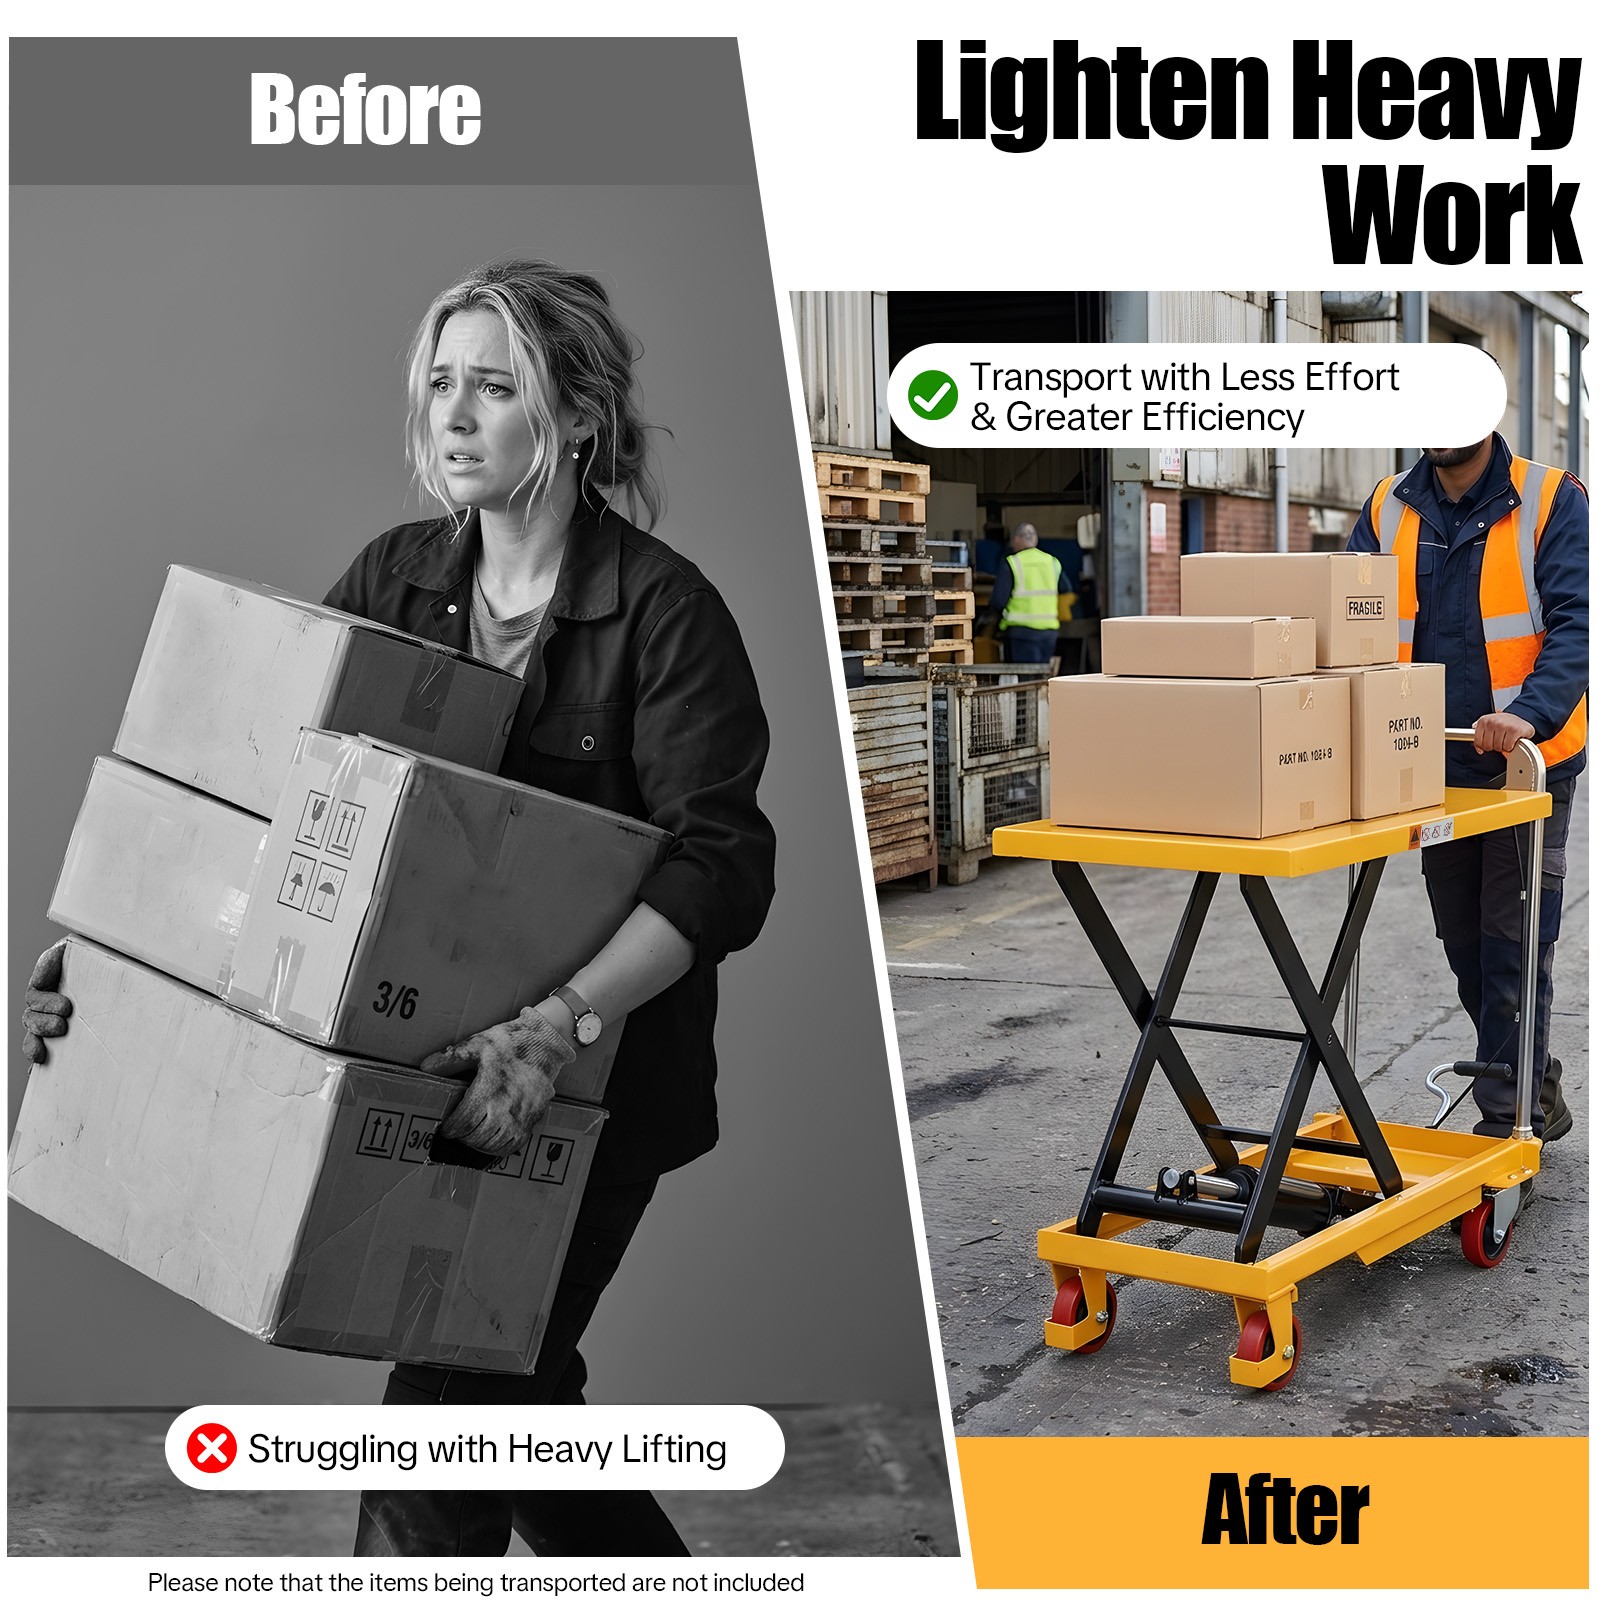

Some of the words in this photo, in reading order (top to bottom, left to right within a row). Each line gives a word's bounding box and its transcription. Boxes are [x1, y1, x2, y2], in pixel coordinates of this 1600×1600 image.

[1348, 600, 1383, 616] FRAGILE
[372, 980, 419, 1020] 3/6
[407, 1129, 434, 1151] 3/6
